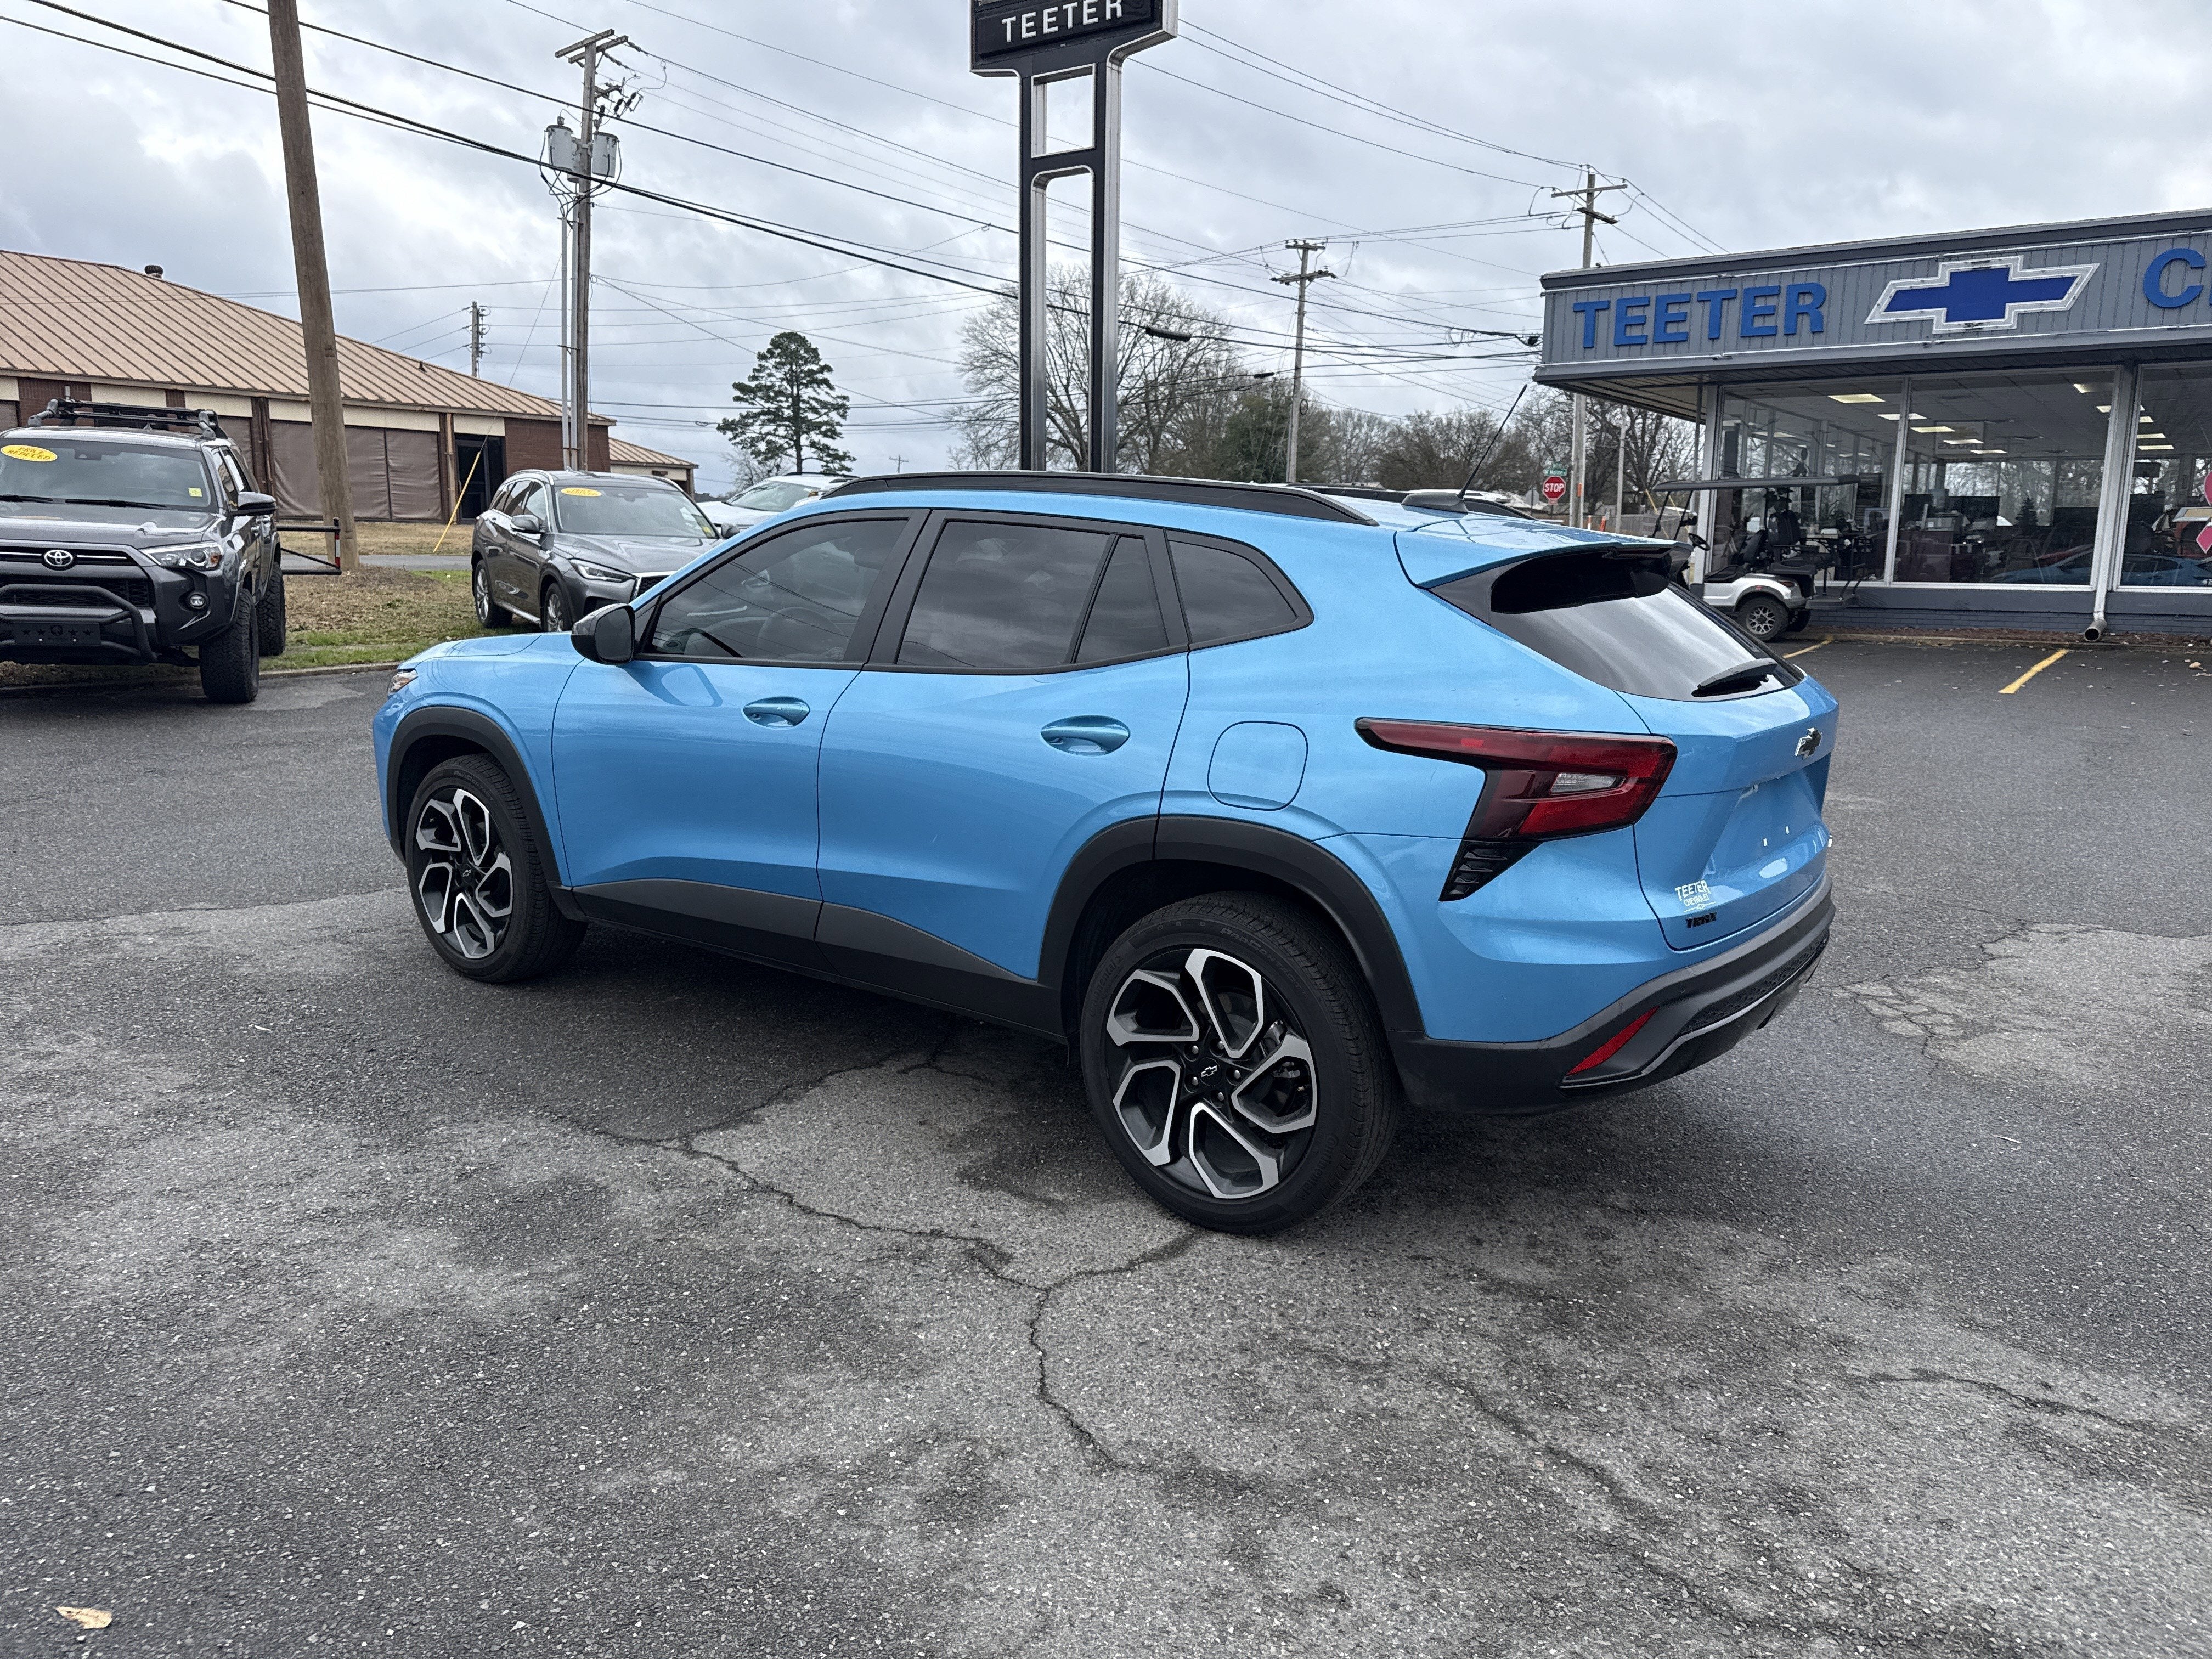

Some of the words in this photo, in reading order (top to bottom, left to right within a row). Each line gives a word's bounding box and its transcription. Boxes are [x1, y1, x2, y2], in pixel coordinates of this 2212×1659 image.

[1001, 0, 1122, 43] TEETER
[1573, 283, 1827, 348] TEETER
[2143, 248, 2212, 309] C
[7, 449, 50, 460] REDUCED
[1544, 483, 1564, 493] STOP
[1675, 880, 1711, 901] TEETER
[1684, 894, 1709, 906] CHEVROLET
